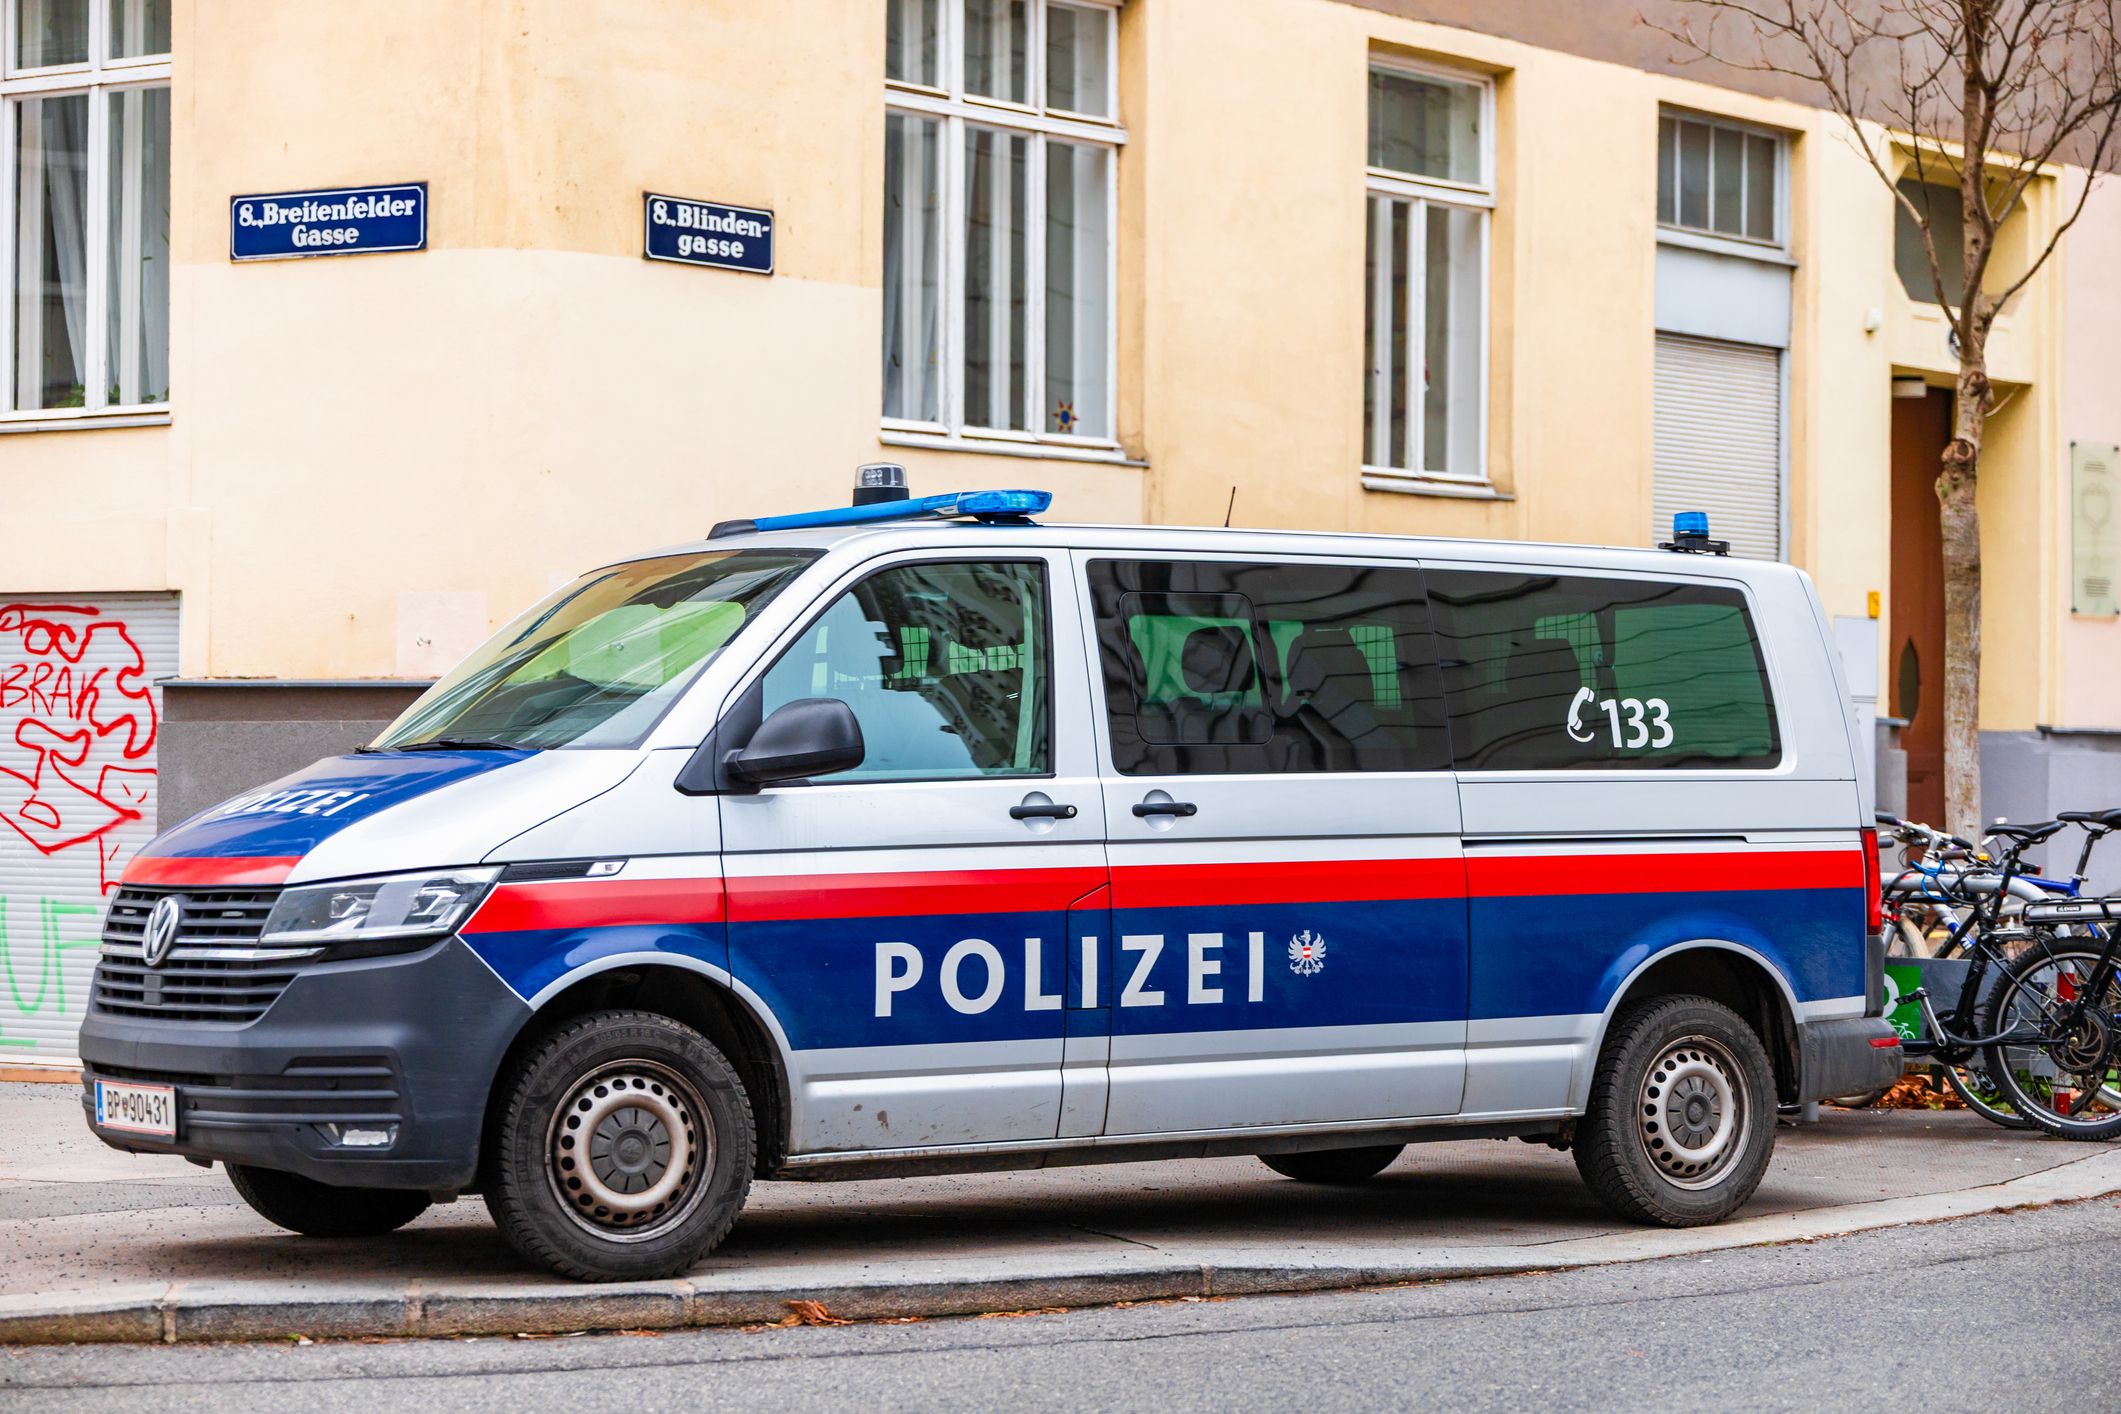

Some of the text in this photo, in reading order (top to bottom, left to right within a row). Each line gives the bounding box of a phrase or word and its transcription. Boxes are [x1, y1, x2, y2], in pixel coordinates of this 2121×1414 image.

[291, 225, 360, 248] Gasse
[677, 234, 745, 259] gasse
[1599, 697, 1674, 749] 133
[874, 931, 1265, 1017] POLIZEI
[106, 1089, 169, 1126] BP 90431
